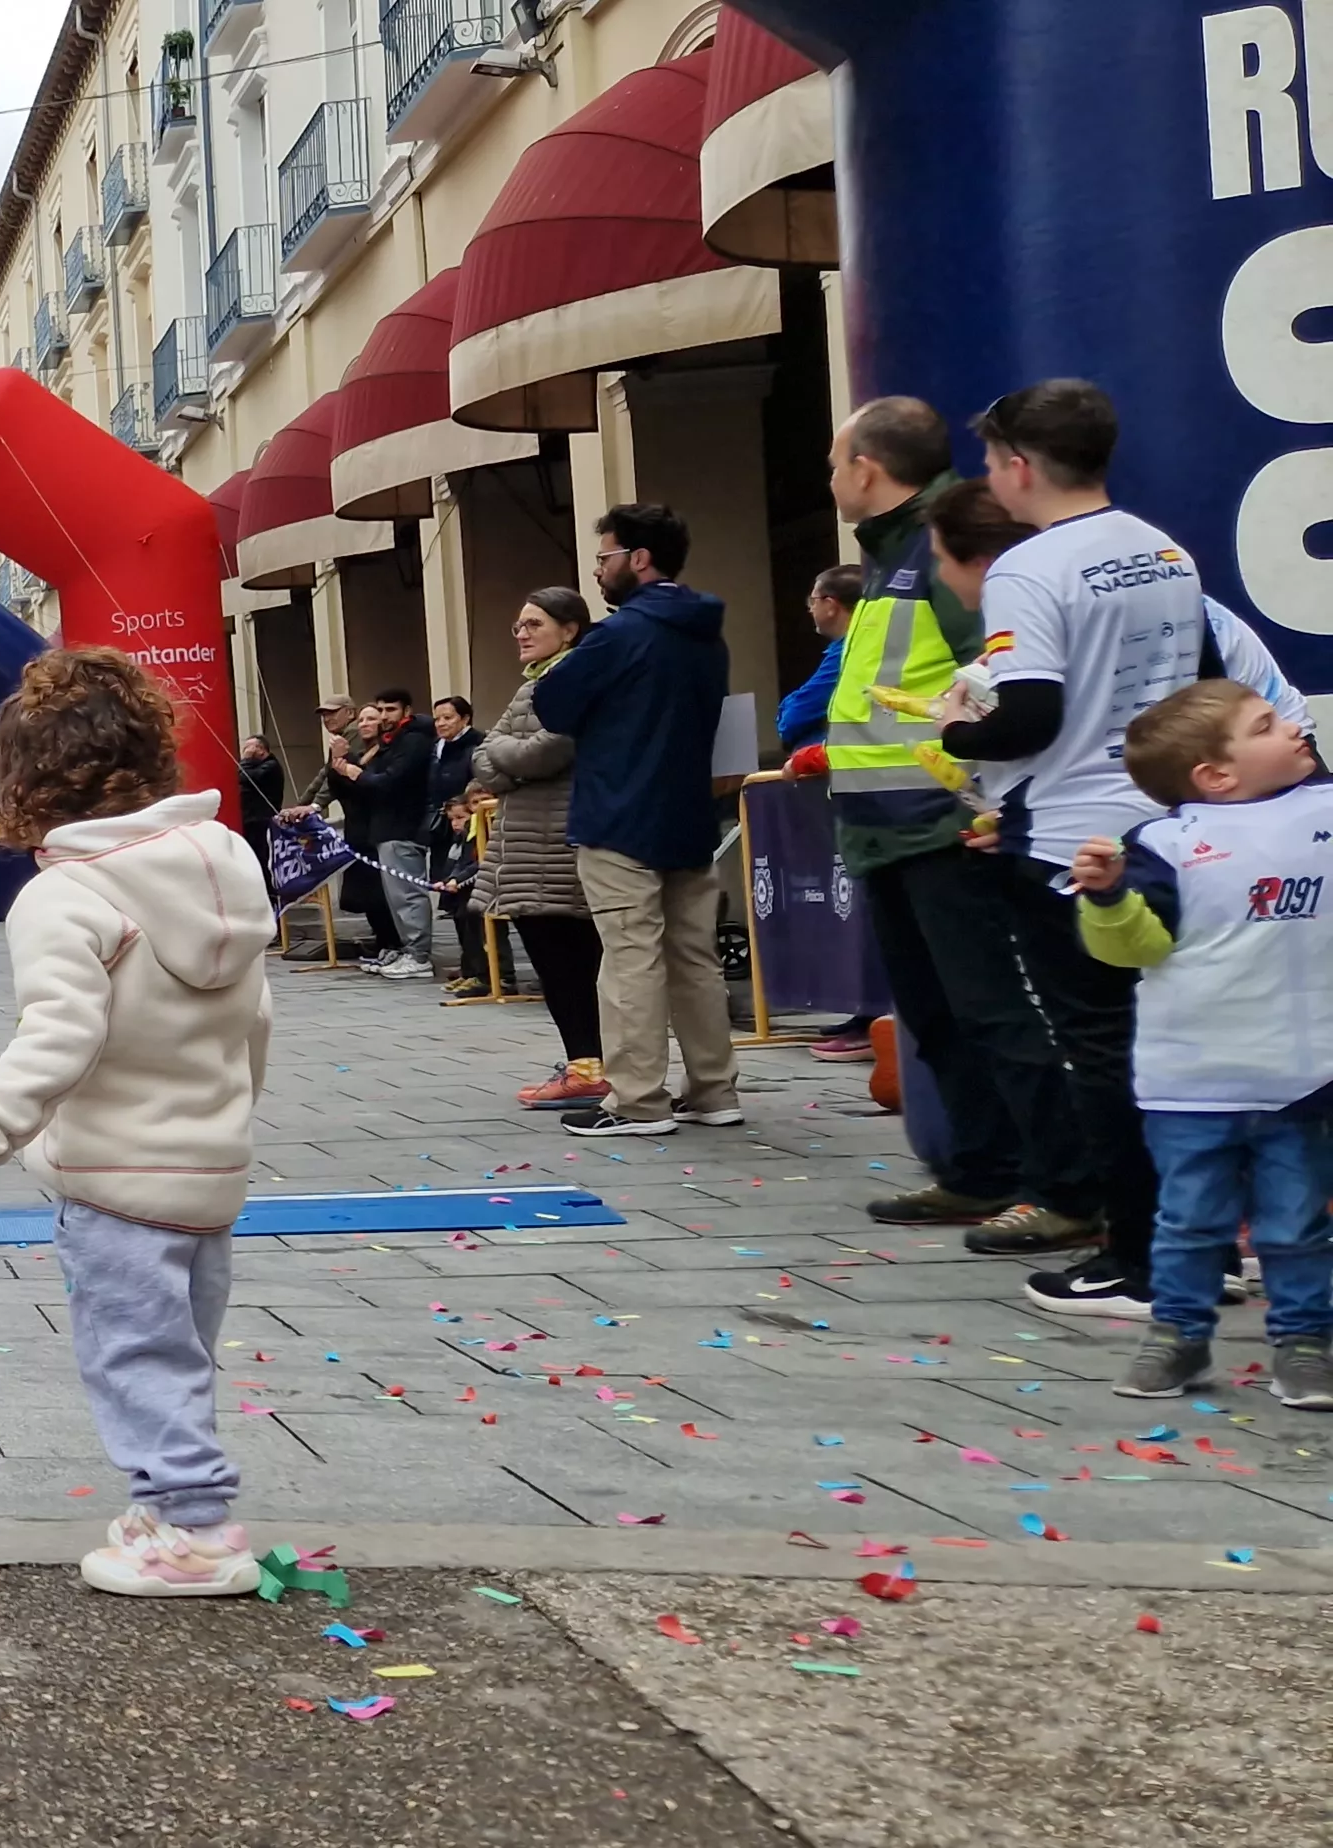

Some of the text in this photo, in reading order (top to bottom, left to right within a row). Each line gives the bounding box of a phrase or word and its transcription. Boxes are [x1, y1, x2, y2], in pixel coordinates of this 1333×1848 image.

[1090, 565, 1194, 598] NACIONAL
[111, 608, 185, 637] Sports
[125, 642, 216, 666] antander
